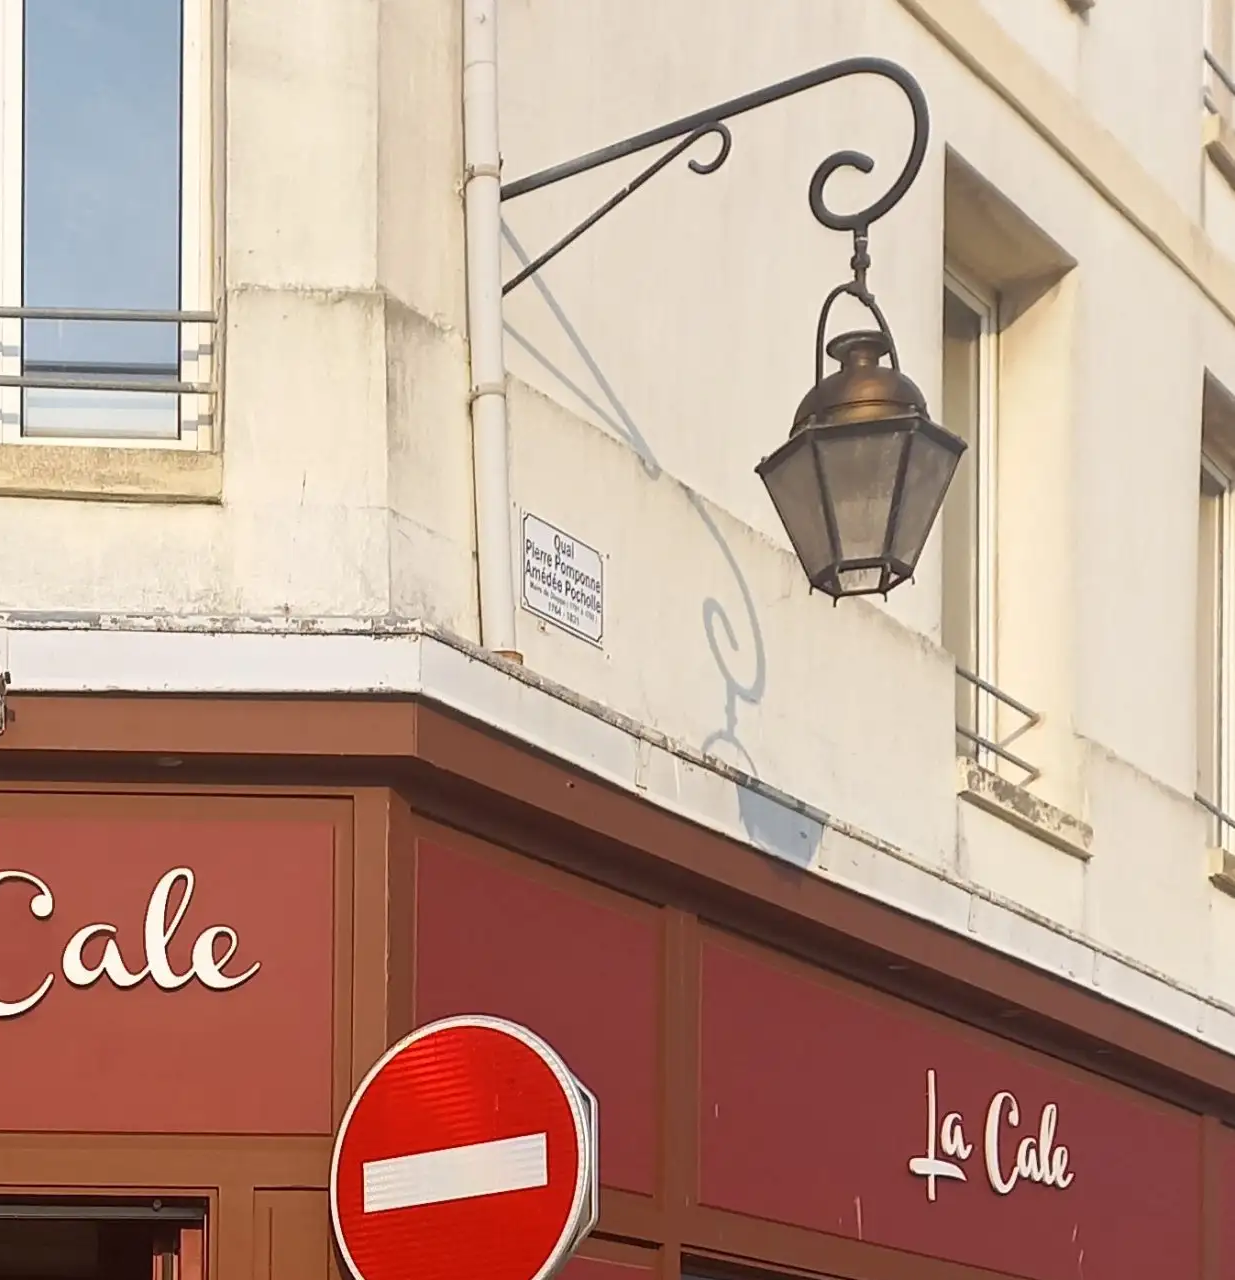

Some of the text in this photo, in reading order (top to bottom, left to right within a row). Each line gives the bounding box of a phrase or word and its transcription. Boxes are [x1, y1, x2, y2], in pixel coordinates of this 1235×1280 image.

[526, 539, 601, 593] Pierre Pomponne
[554, 535, 574, 559] Quai
[525, 560, 563, 593] Amédée
[565, 581, 601, 613] Pocholle
[909, 1069, 1074, 1201] La Cale
